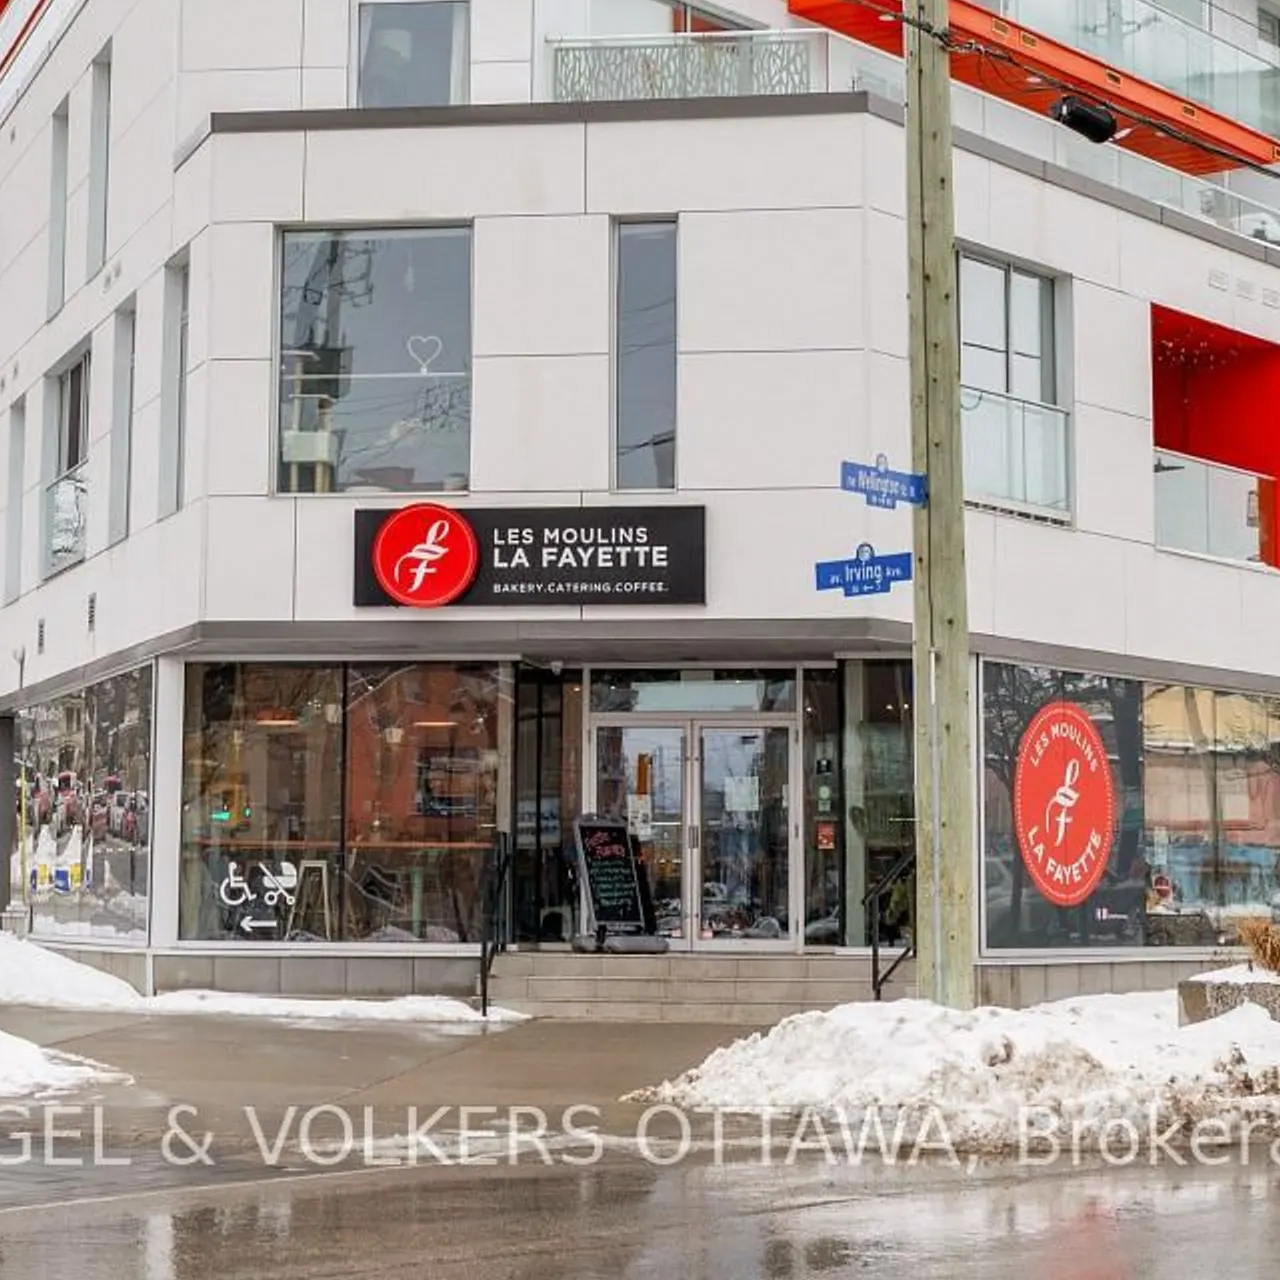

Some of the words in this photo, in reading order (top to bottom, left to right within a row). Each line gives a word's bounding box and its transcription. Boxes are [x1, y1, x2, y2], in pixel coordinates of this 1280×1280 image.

[493, 528, 534, 545] LES
[543, 527, 648, 544] MOULINS
[493, 547, 530, 568] LA
[542, 546, 668, 568] FAYETTE
[844, 561, 882, 584] Irving
[1030, 732, 1050, 768] LES
[1051, 722, 1098, 773] MOULINS
[1028, 825, 1046, 863] LA
[1045, 828, 1103, 886] FAYETTE
